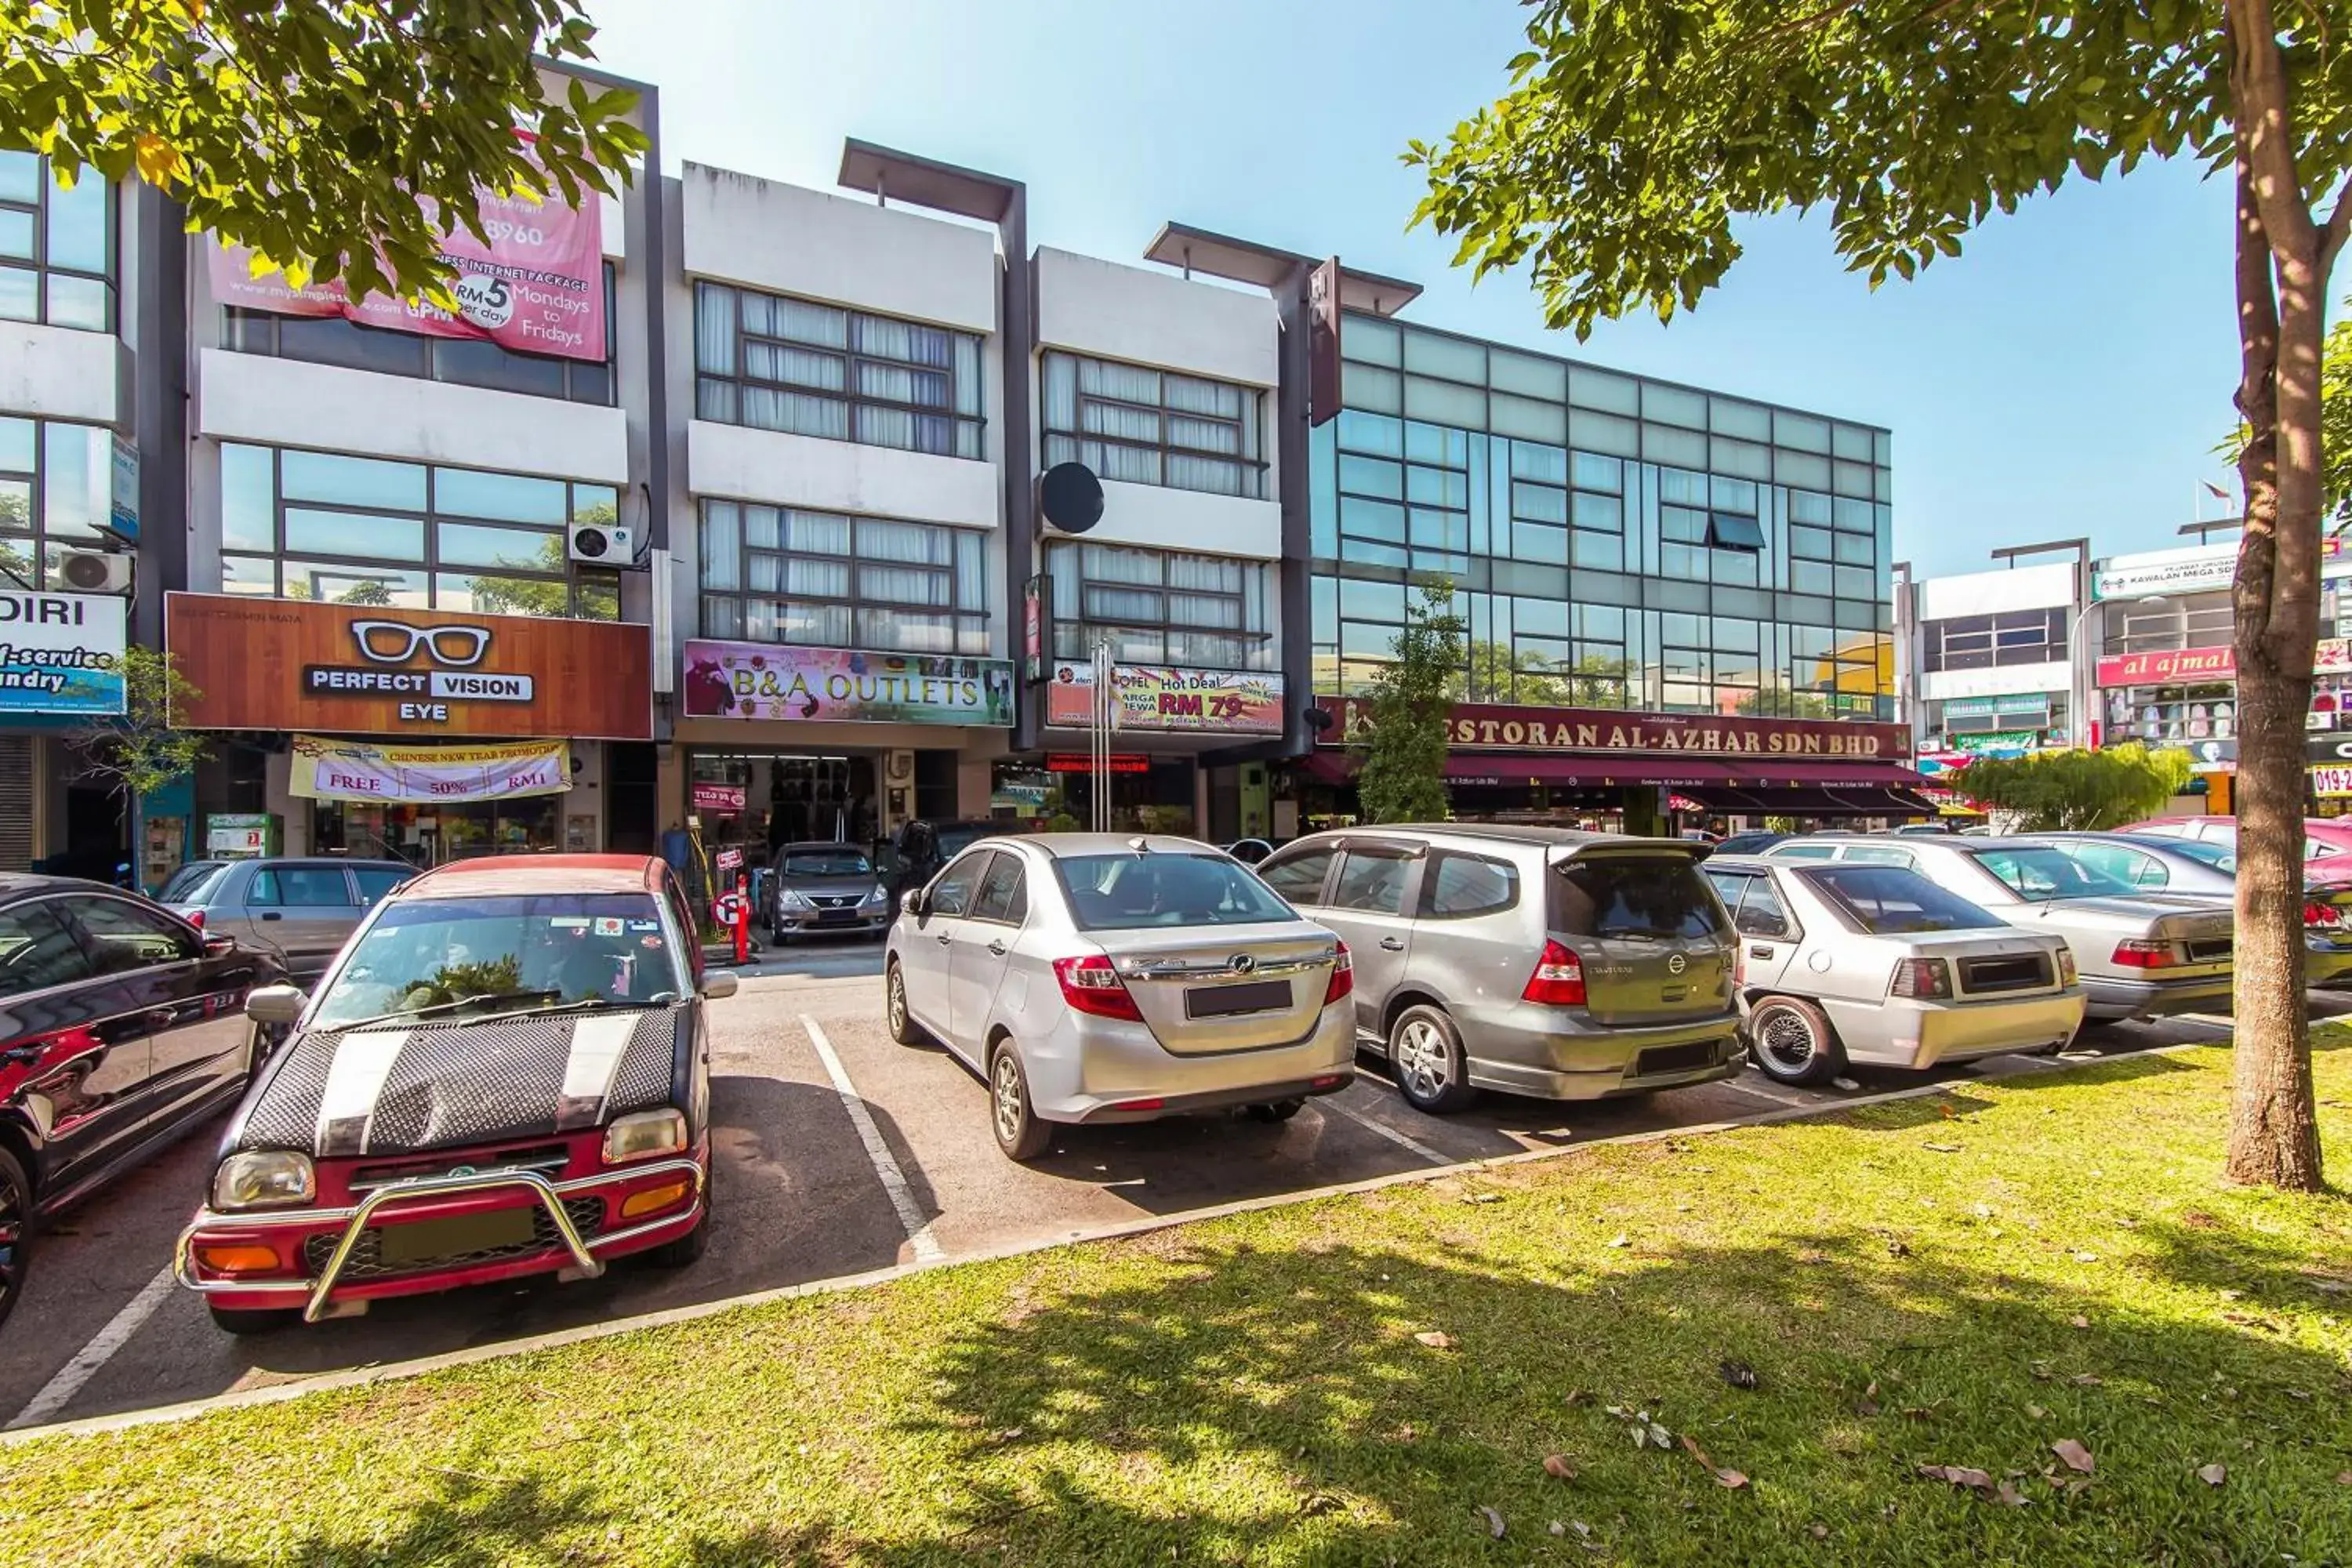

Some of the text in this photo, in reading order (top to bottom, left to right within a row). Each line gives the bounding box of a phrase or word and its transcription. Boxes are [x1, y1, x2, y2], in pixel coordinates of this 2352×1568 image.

[485, 219, 543, 246] 8960
[470, 260, 524, 281] INTERNET
[528, 271, 589, 292] PACKAGE
[457, 278, 510, 308] RM 5
[512, 285, 590, 314] Mondays
[481, 307, 508, 324] day
[544, 310, 560, 322] to
[522, 319, 582, 347] Fridays
[2130, 573, 2180, 584] KAWALAN
[2183, 568, 2214, 579] MEGA
[2125, 649, 2231, 680] al ajmal
[313, 670, 520, 696] PERFECT VISION
[733, 669, 978, 706] B&A OUTLETS
[1120, 675, 1221, 691] OTEL Hot Deal
[401, 703, 448, 720] EYE
[1158, 693, 1203, 717] RM
[1208, 695, 1243, 717] 79
[1443, 718, 1879, 755] ESTORAN AL-AZHAR SDN BHD
[390, 753, 437, 763] CHINESE
[440, 752, 465, 761] NEW
[470, 750, 499, 760] YEAR
[330, 774, 381, 791] FREE
[430, 782, 467, 795] 50%
